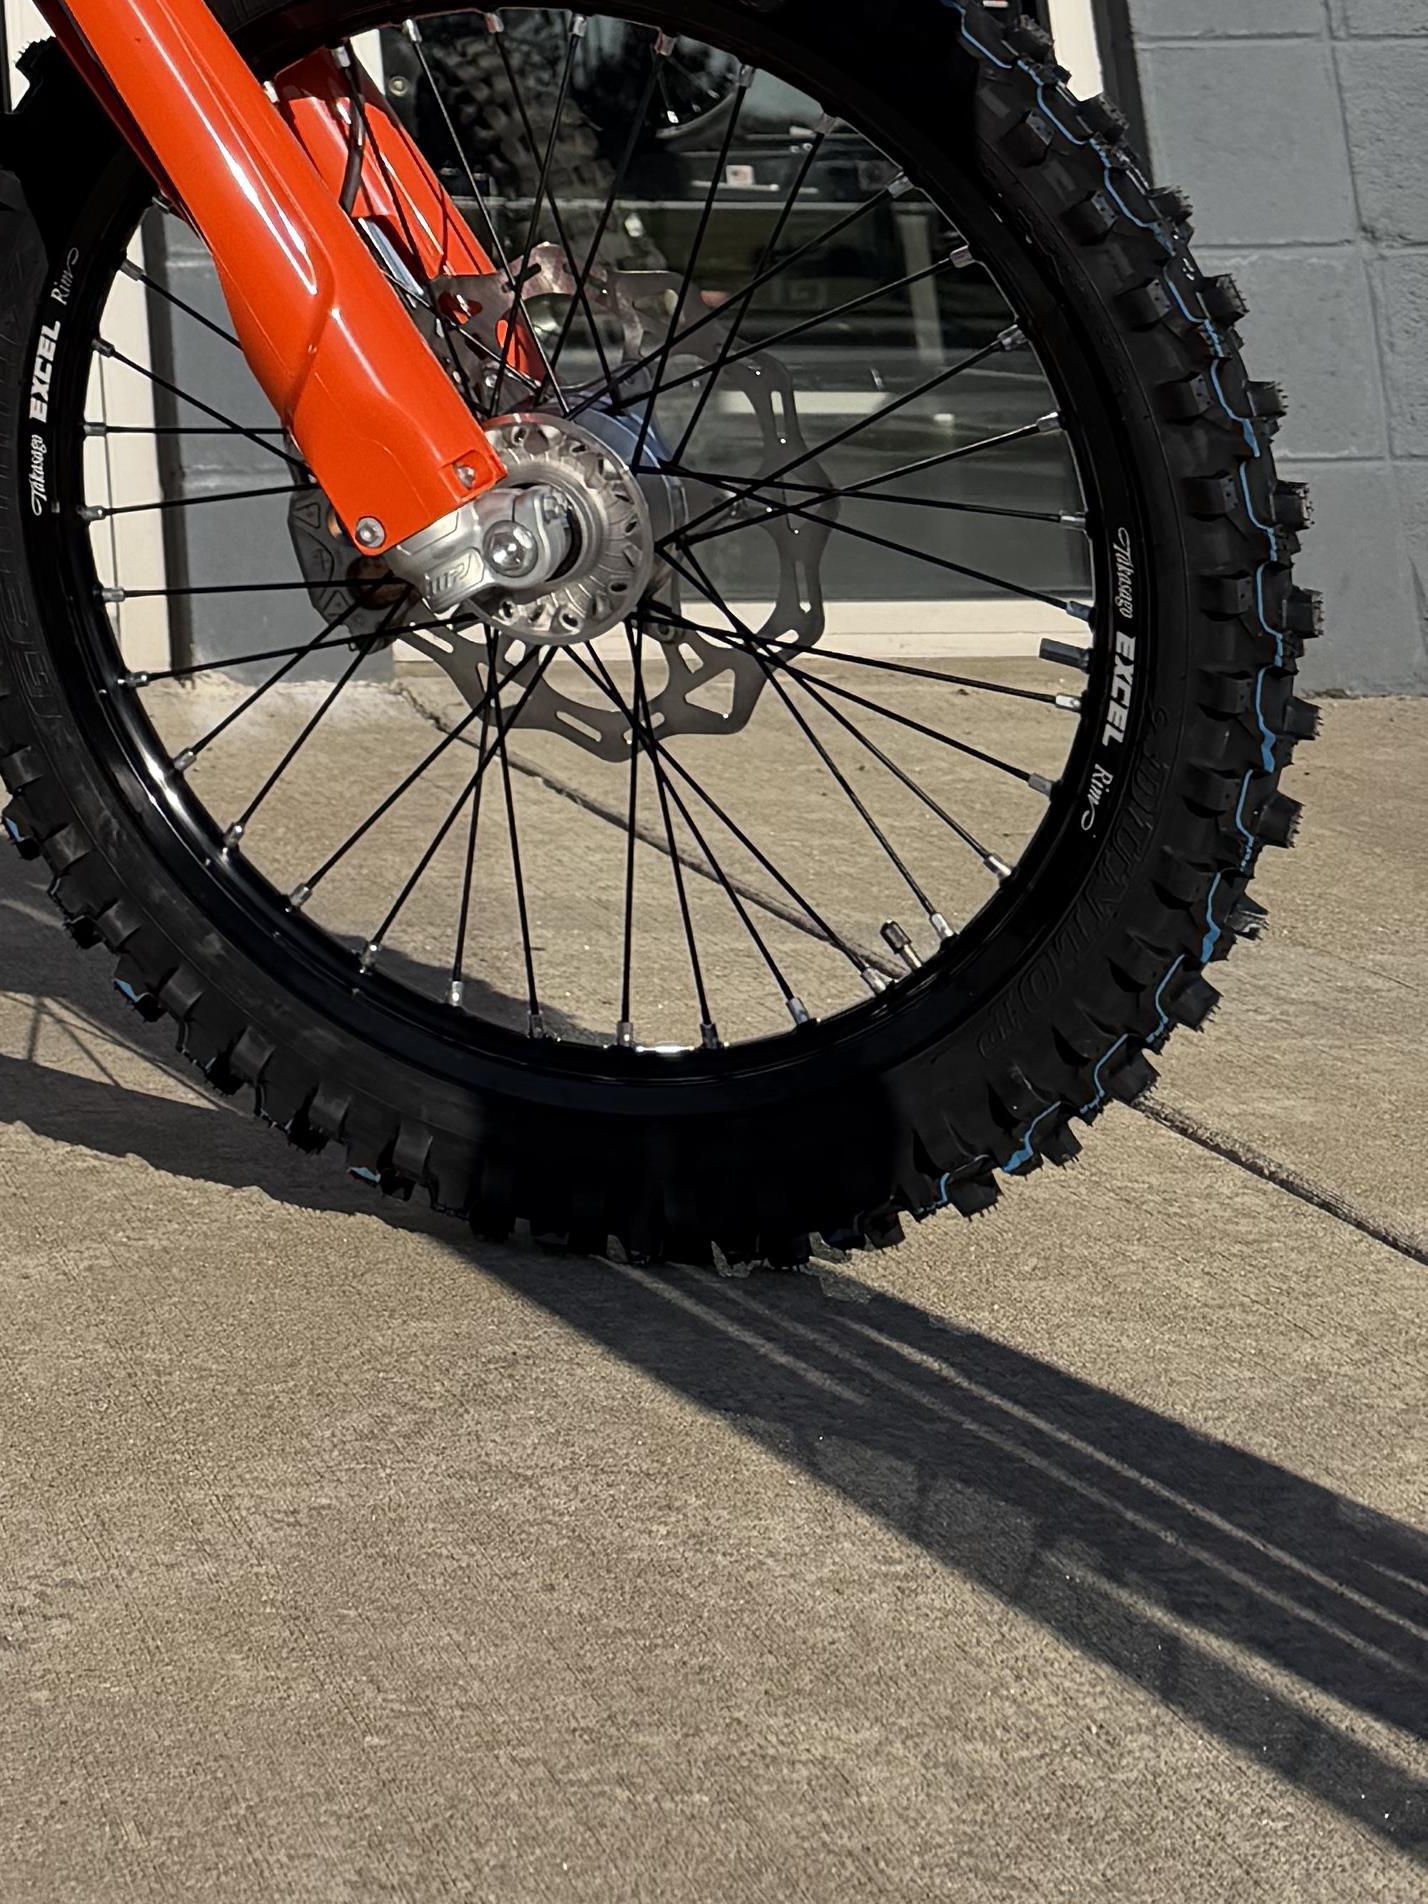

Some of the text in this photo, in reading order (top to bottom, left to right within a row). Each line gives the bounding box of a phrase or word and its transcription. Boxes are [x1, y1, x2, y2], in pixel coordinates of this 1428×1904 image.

[28, 247, 80, 517] Takasago EXCEL Rim
[1081, 527, 1137, 832] Takasago EXCEL Rim
